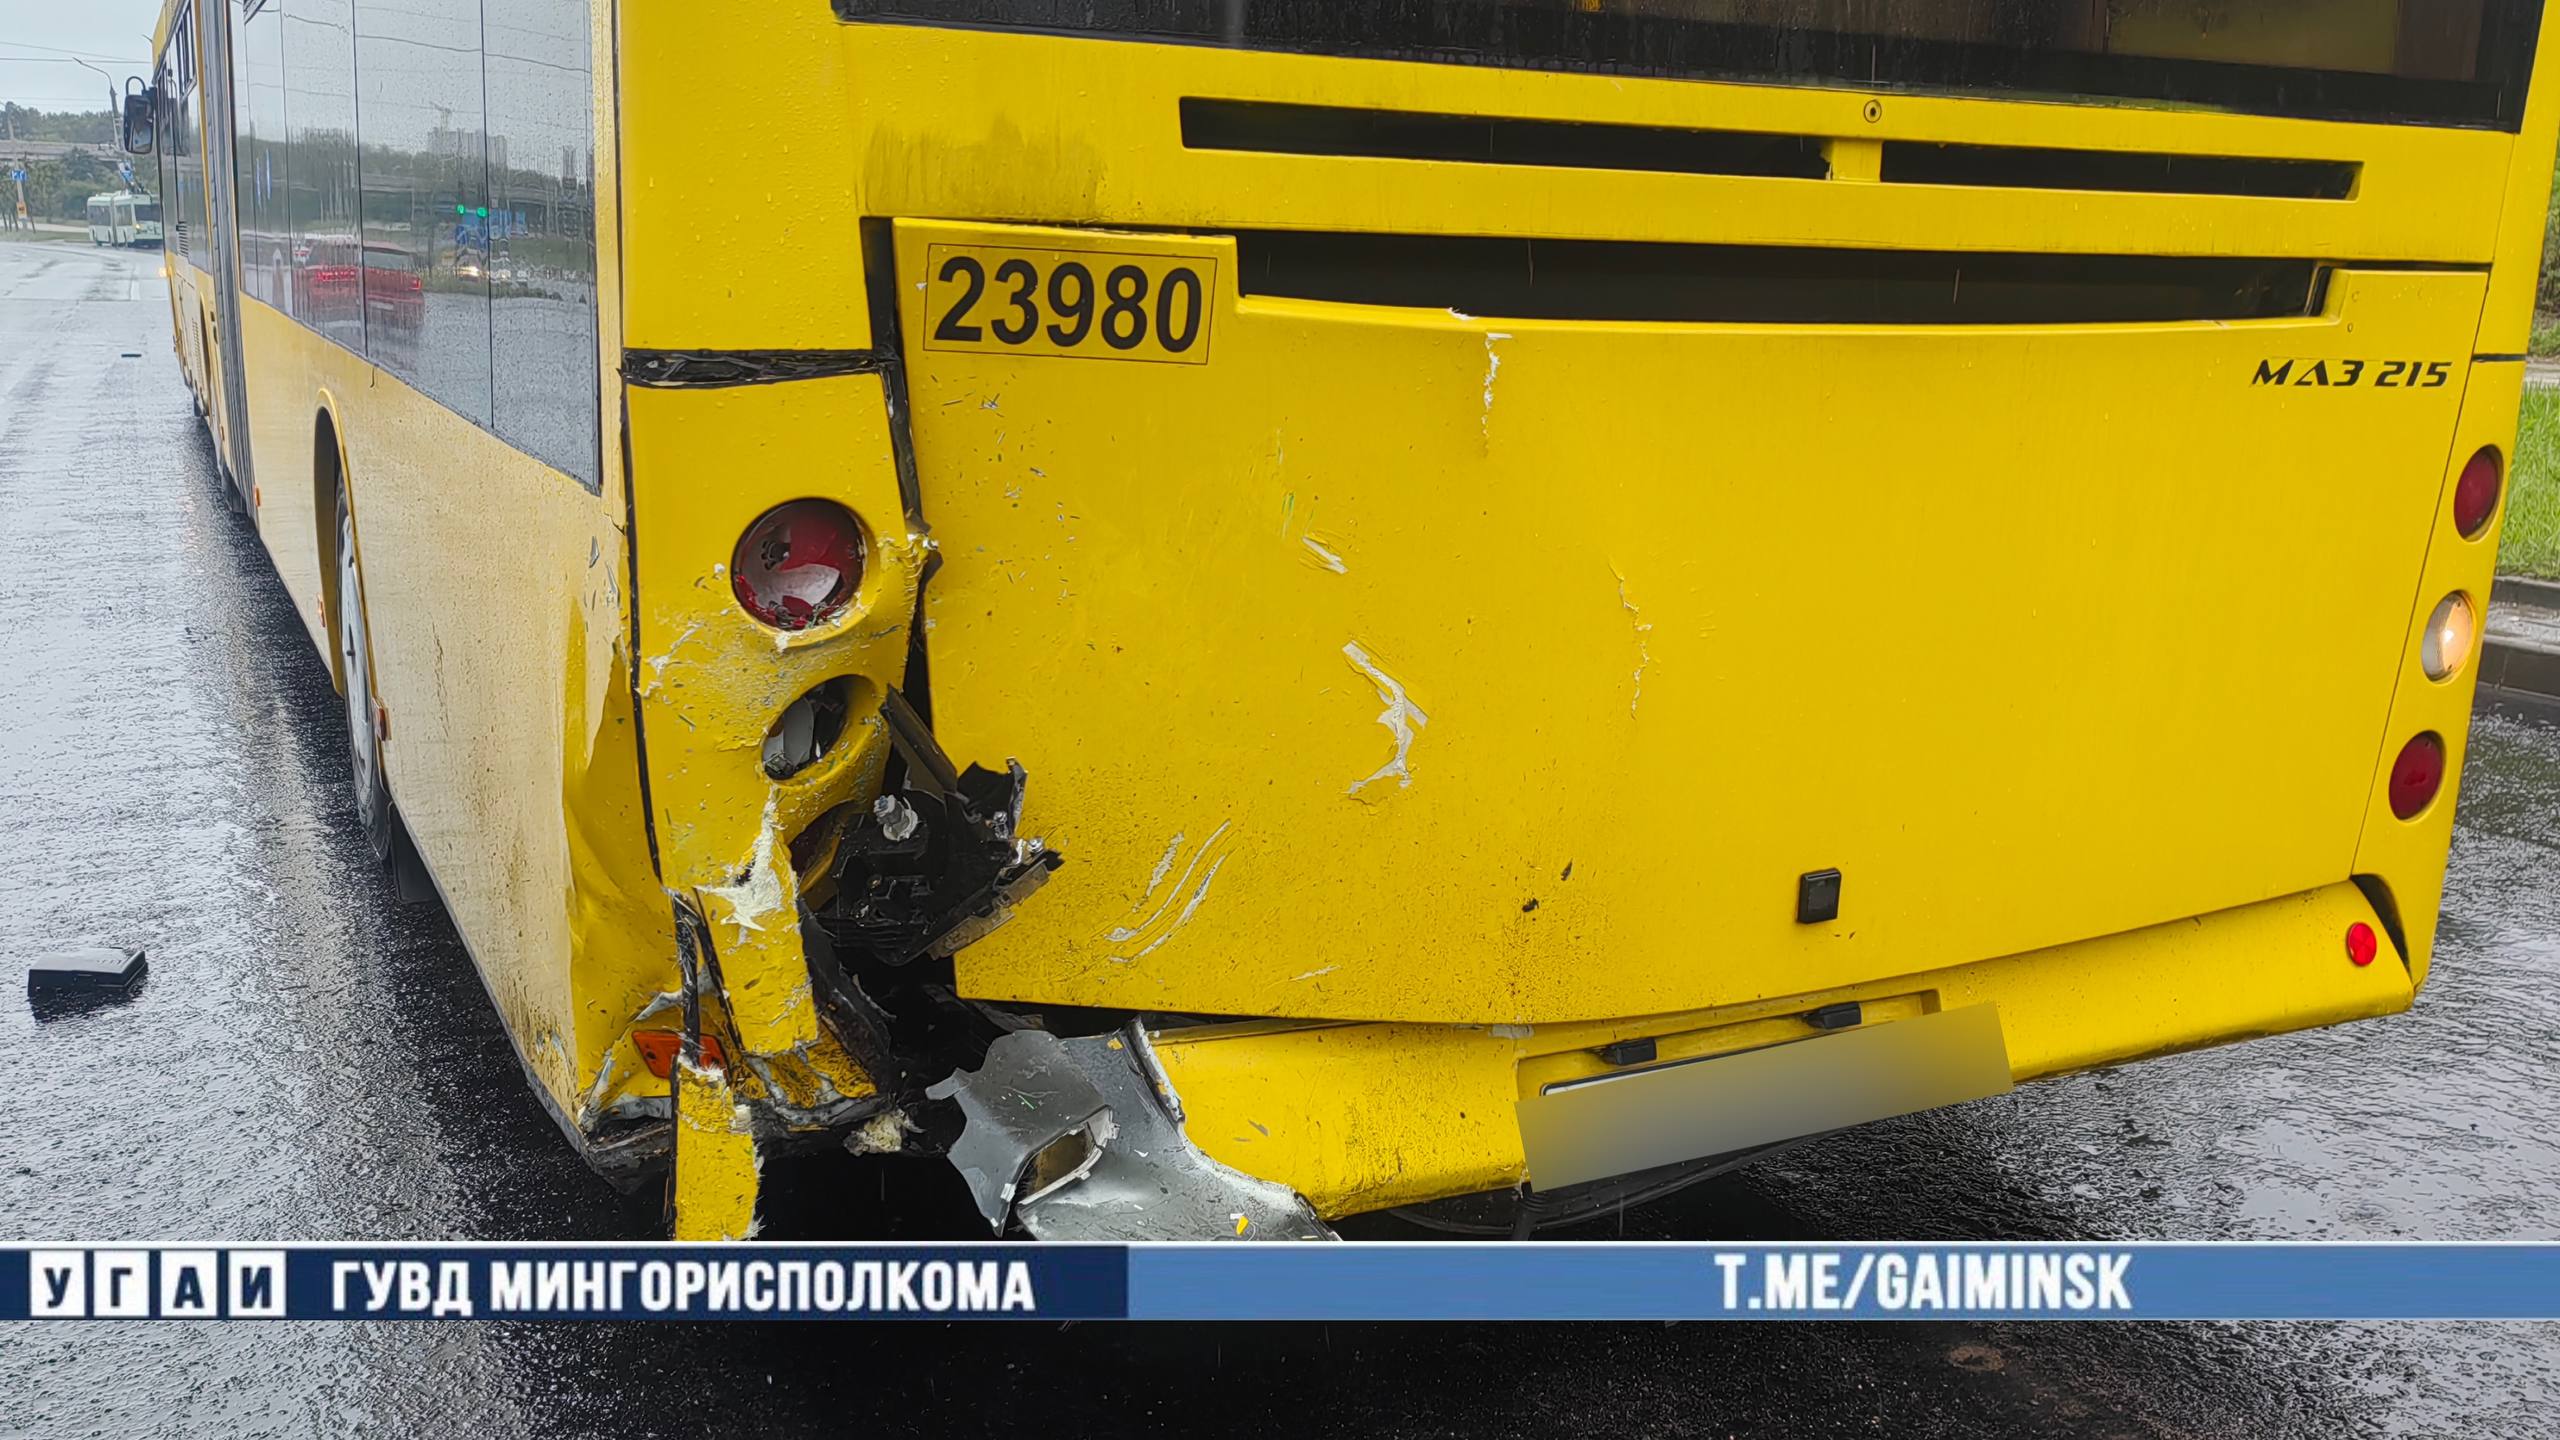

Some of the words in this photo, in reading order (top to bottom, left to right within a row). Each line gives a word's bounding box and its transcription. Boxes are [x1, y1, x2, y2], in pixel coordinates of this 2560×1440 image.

[933, 255, 1202, 353] 23980
[2251, 359, 2364, 387] МАЗ
[2374, 361, 2453, 387] 215
